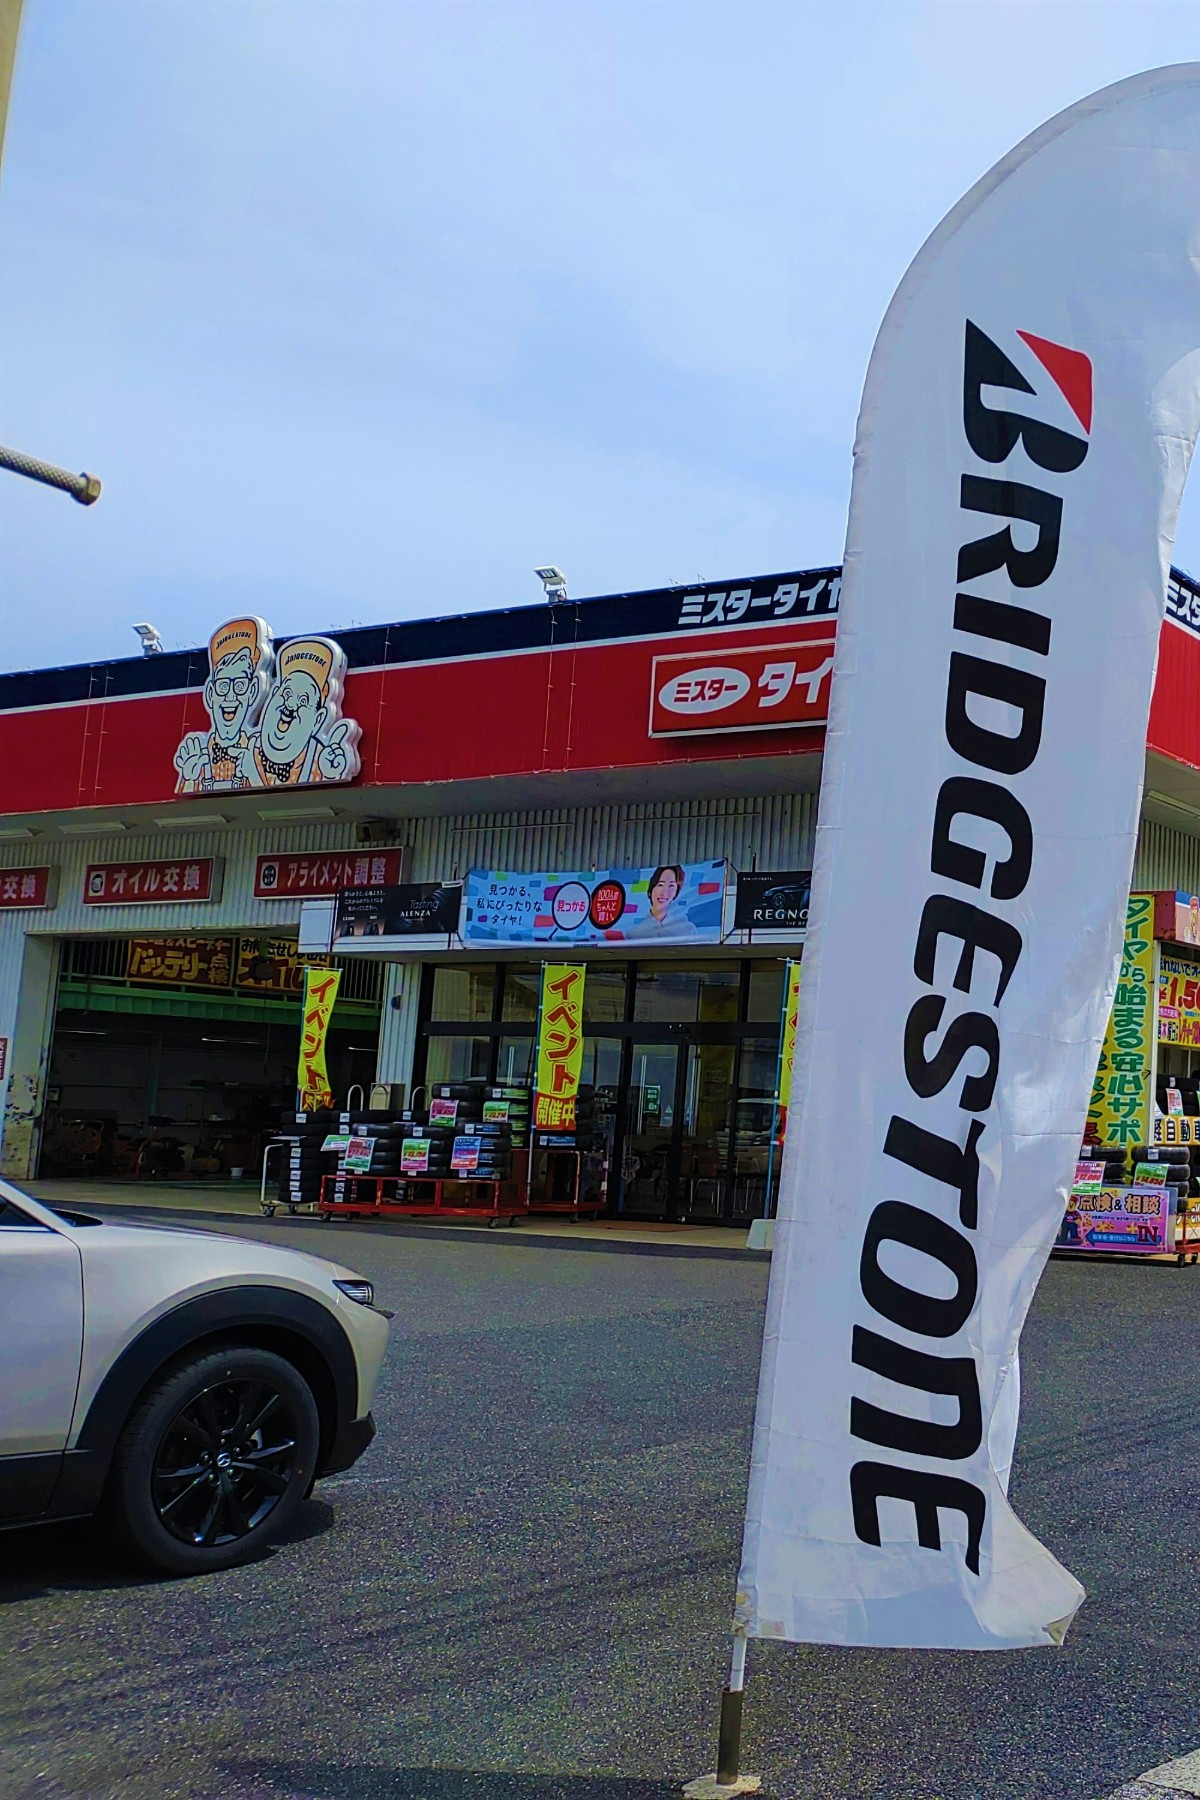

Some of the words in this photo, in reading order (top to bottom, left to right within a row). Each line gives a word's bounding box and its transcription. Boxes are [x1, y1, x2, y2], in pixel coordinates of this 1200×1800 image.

[216, 631, 252, 650] BRIDGESTONE
[285, 652, 327, 667] BRIDGESTONE
[673, 678, 739, 703] ミスター
[112, 865, 201, 895] オイル交換
[286, 856, 387, 889] アライメント調整
[1, 875, 36, 899] 交換
[400, 909, 431, 918] ALENZA
[409, 899, 439, 911] Tasting
[476, 898, 542, 913] 私にぴったりな
[557, 900, 586, 912] 見つかる
[753, 909, 809, 920] REGNO
[851, 318, 1094, 1576] BRIDGESTONE
[130, 946, 208, 981] バッテリー
[304, 975, 336, 1092] イベント
[545, 970, 582, 1096] イベント
[537, 1096, 576, 1127] 開催中
[1137, 1225, 1160, 1242] IN
